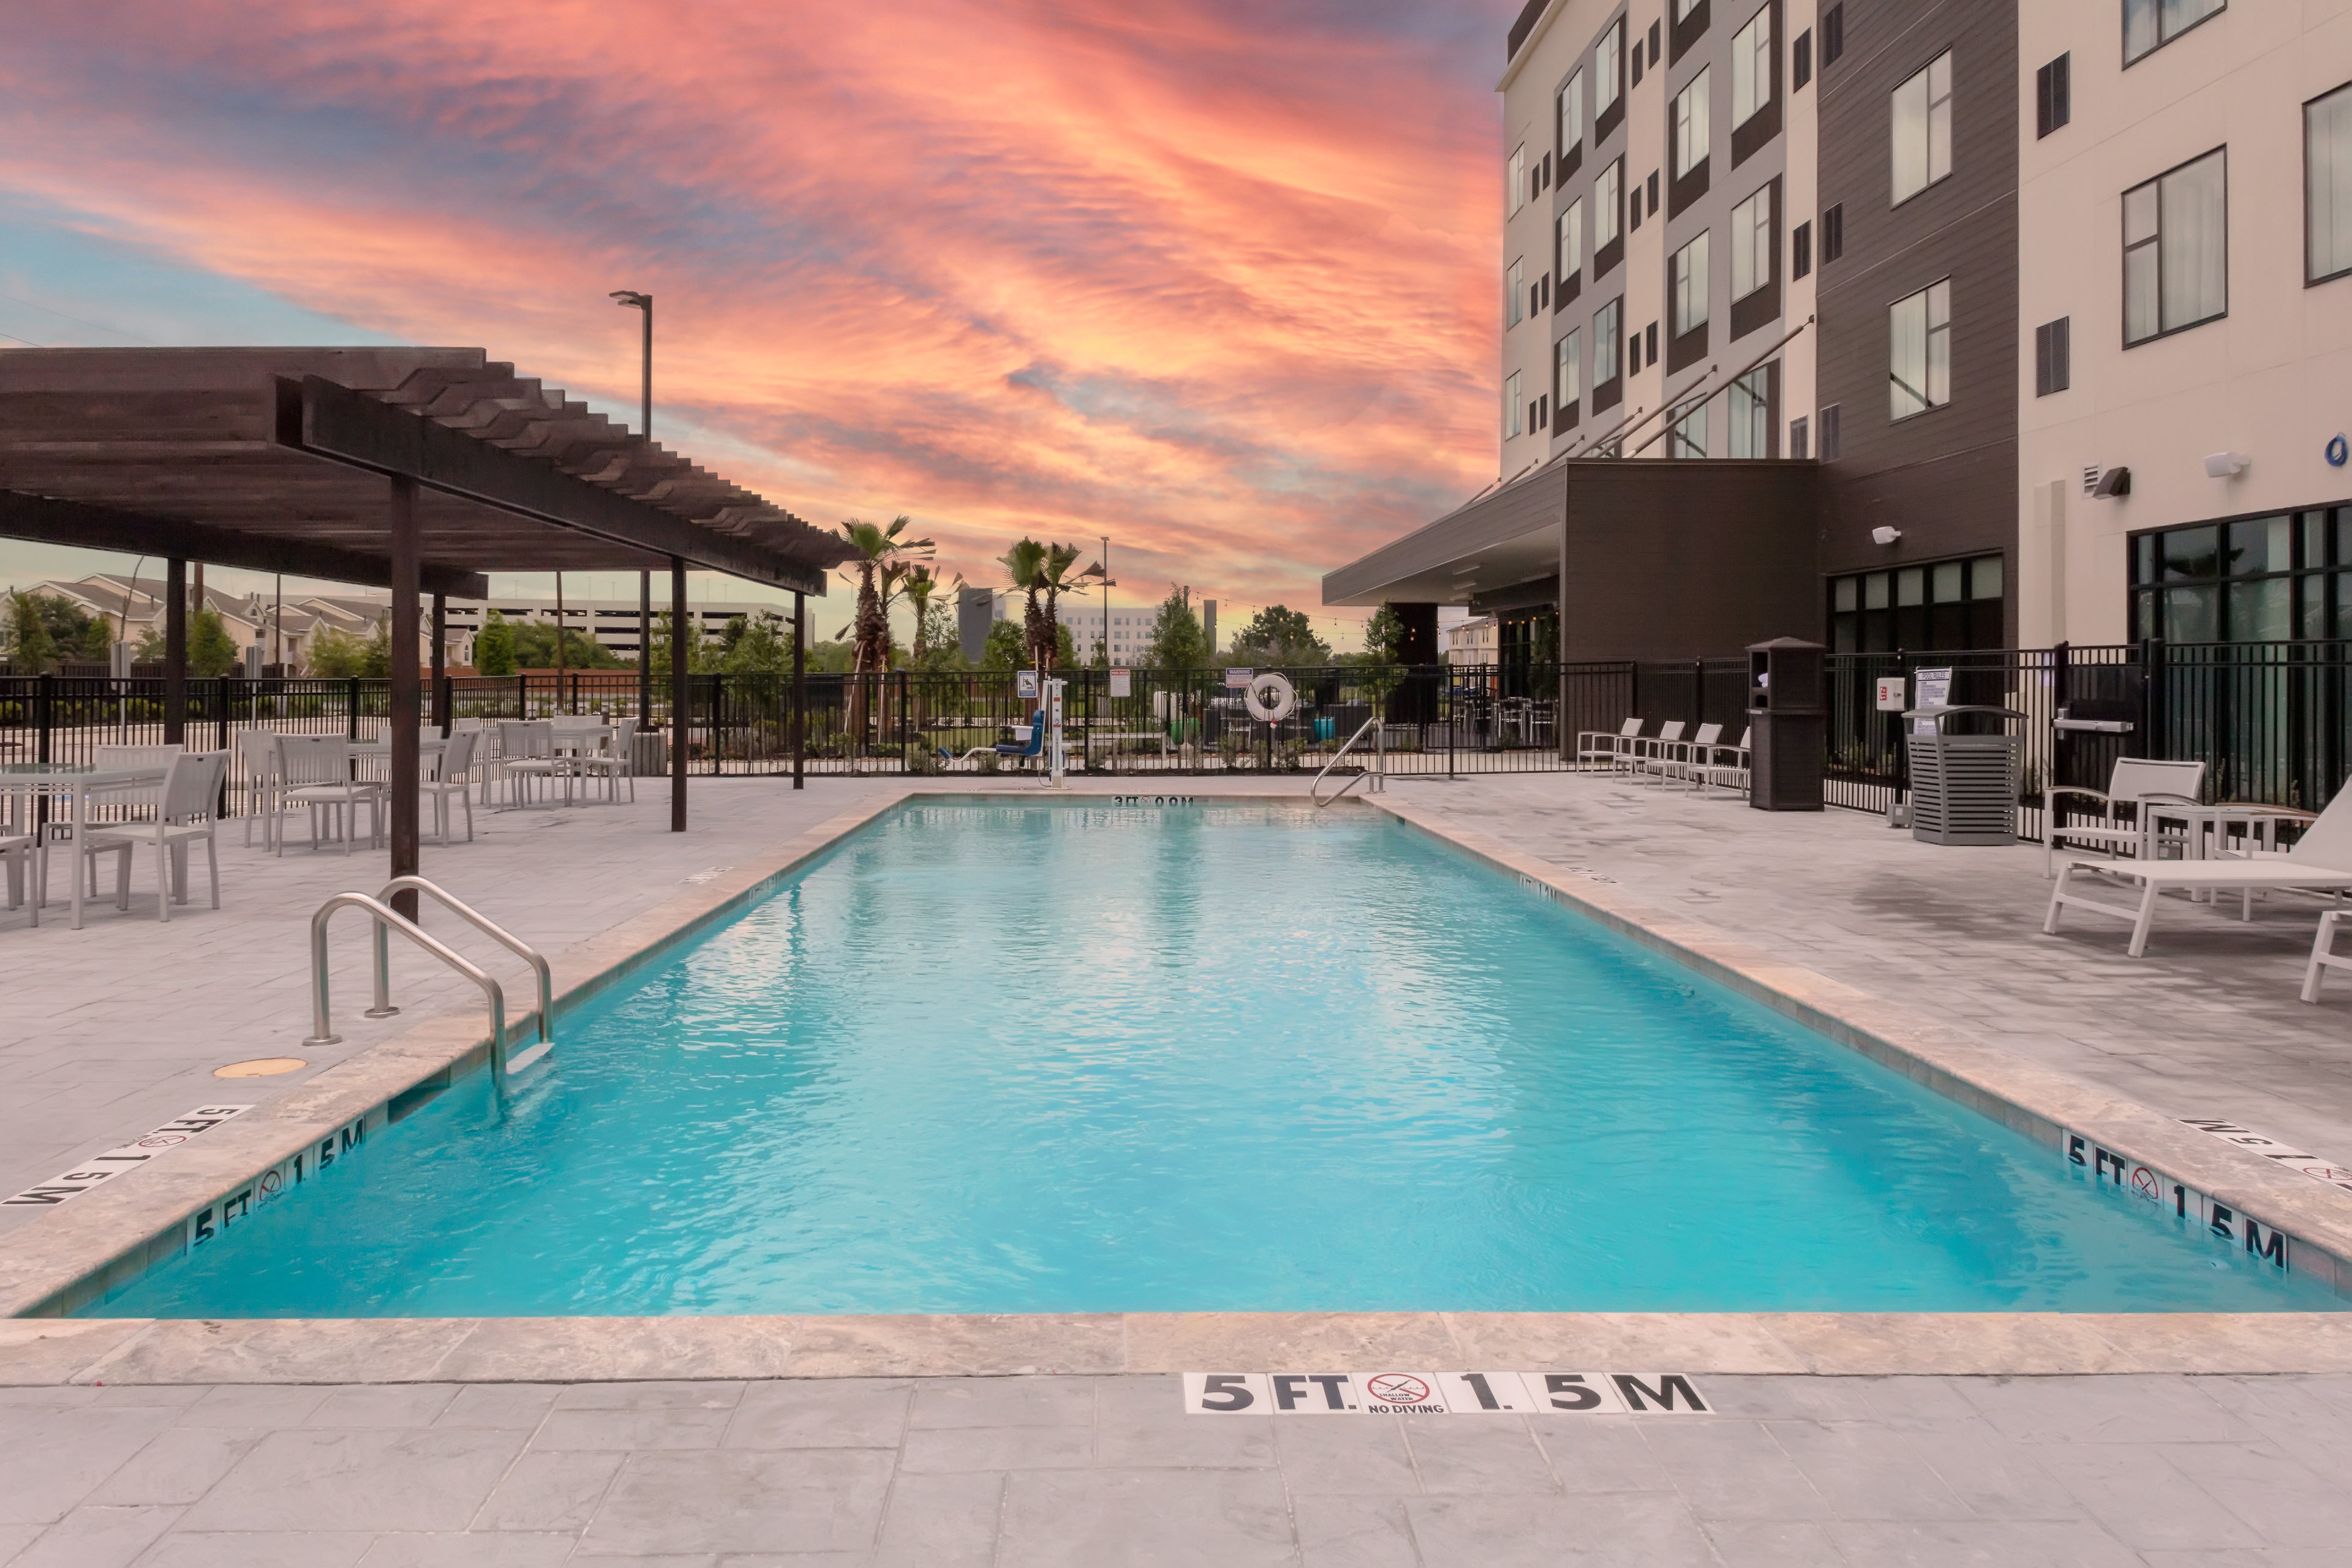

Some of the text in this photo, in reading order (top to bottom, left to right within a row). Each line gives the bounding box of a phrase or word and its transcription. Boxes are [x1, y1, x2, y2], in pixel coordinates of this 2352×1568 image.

[2068, 1134, 2087, 1167] 5
[193, 1207, 214, 1247] 5
[1201, 1374, 1254, 1411] 5
[1272, 1374, 1357, 1410] FT.
[1368, 1405, 1444, 1414] NO DIVING
